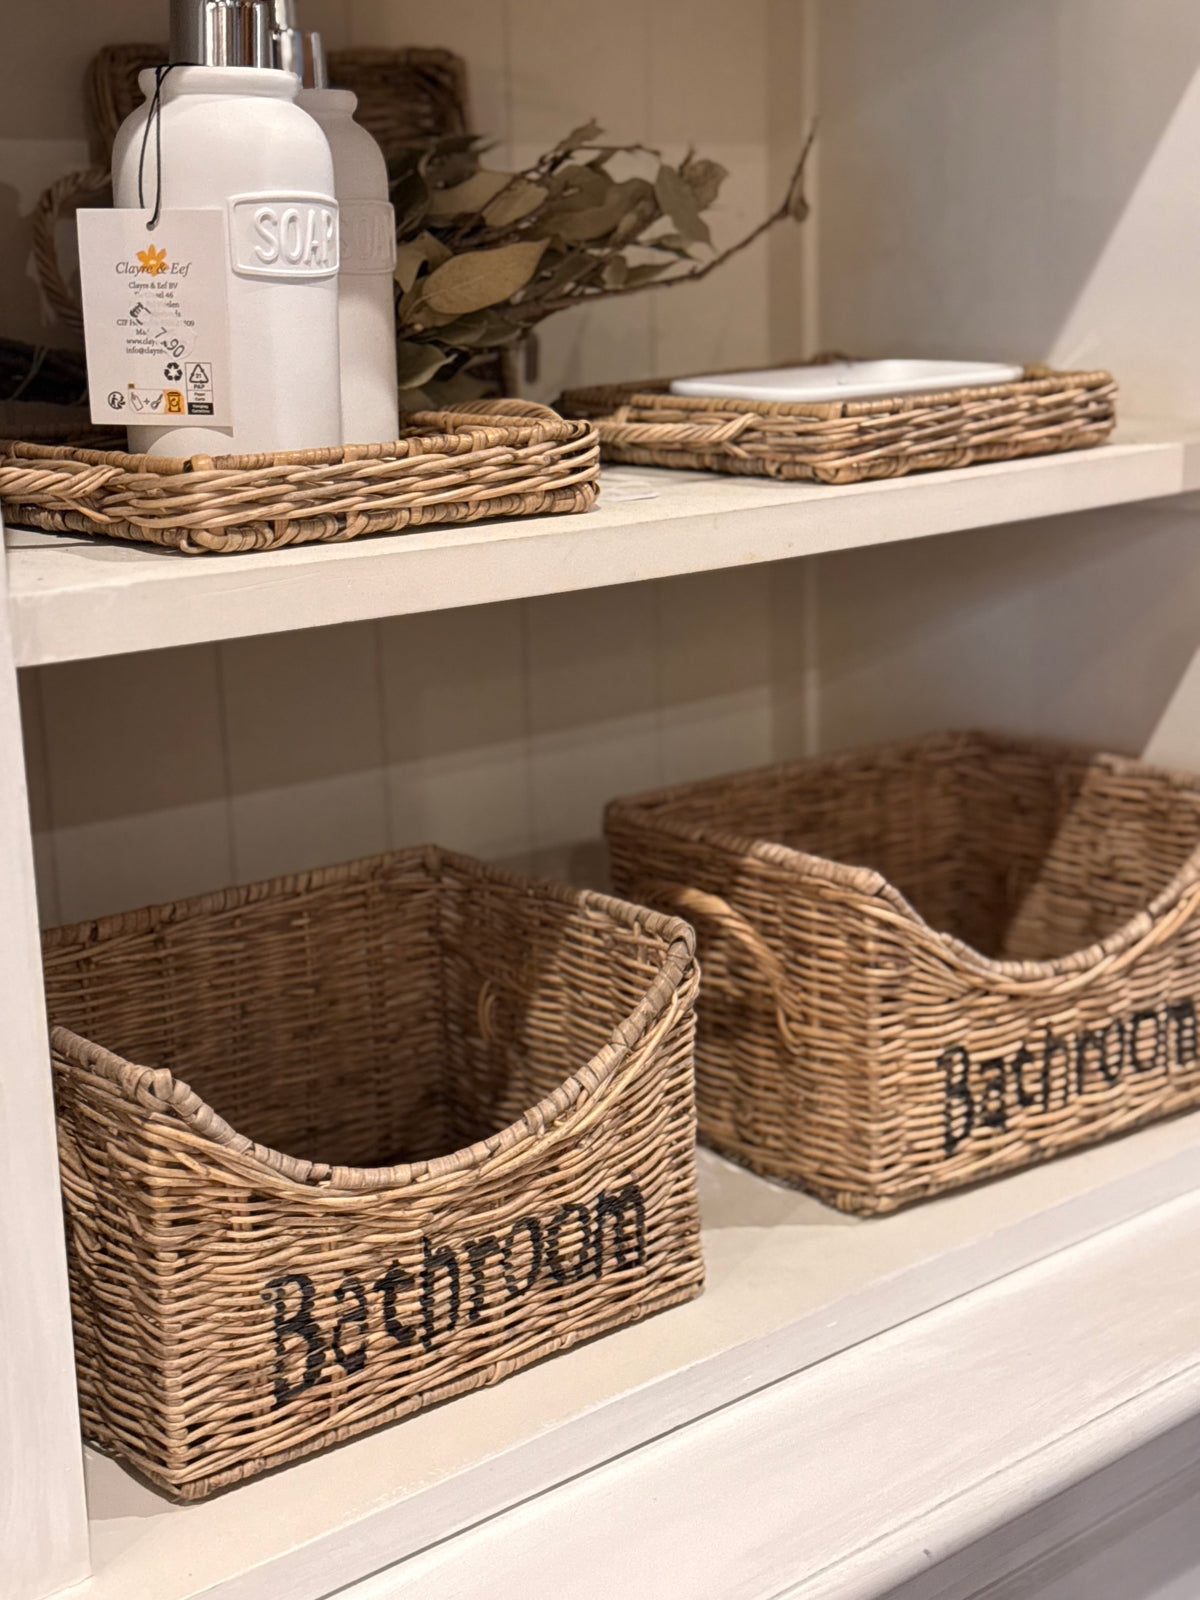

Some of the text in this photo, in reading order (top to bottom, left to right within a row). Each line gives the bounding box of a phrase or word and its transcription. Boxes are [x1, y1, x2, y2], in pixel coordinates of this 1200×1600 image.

[254, 207, 334, 266] SOAP
[115, 262, 192, 278] Clayre & Eef
[128, 281, 149, 292] Clayre
[262, 1184, 646, 1408] Bathroom
